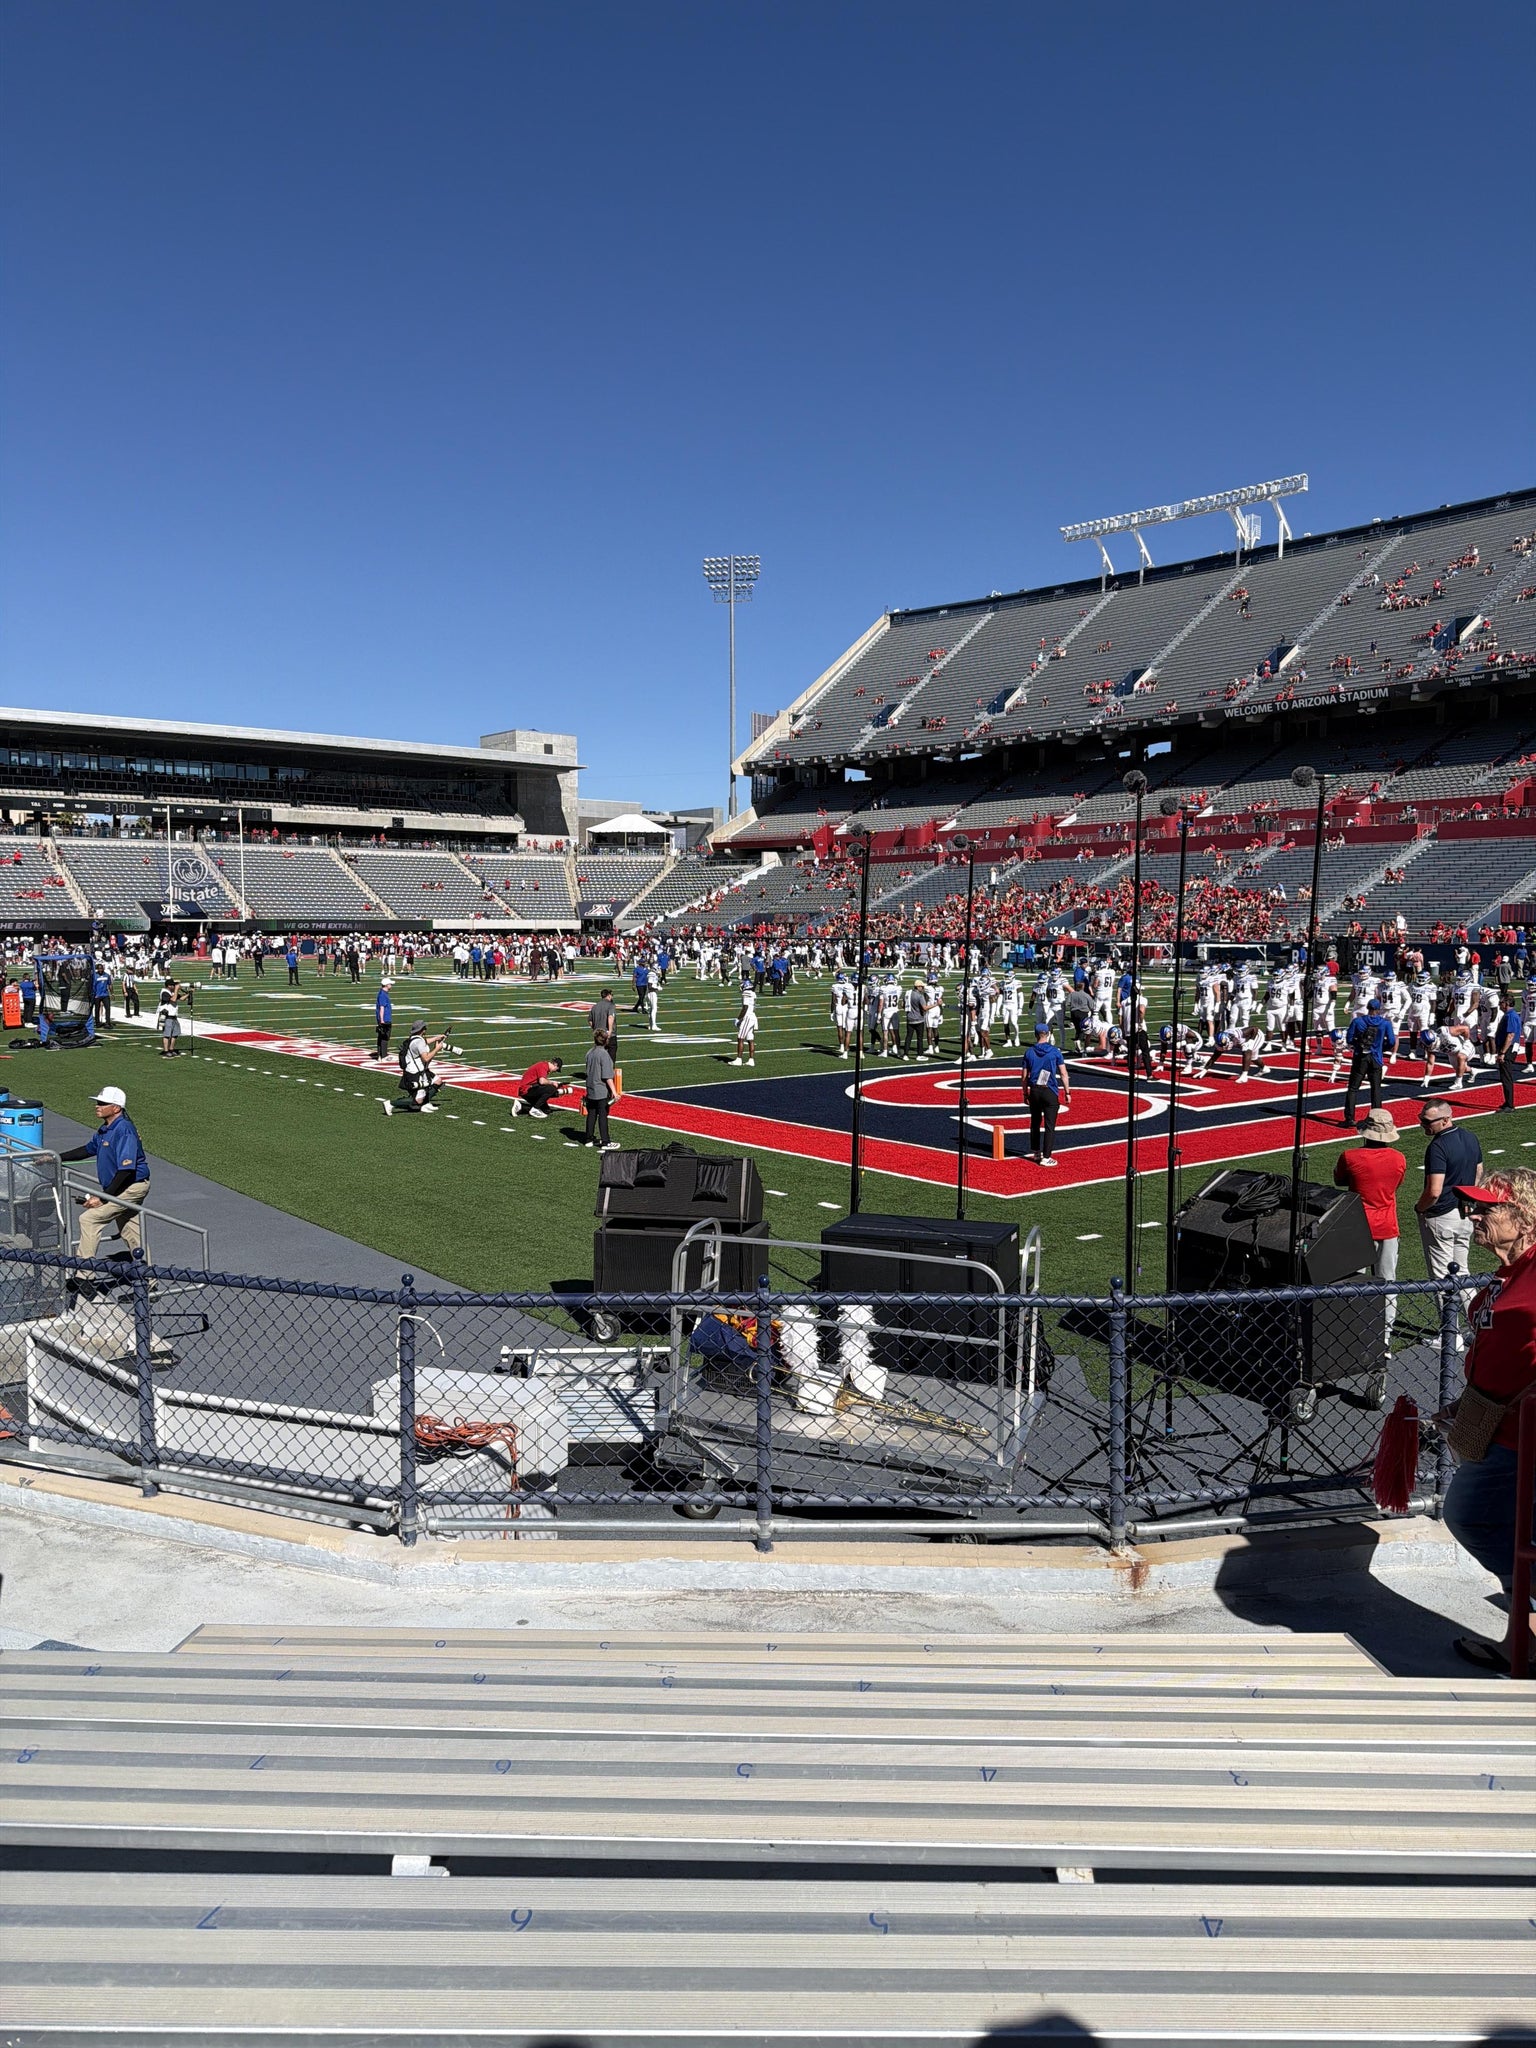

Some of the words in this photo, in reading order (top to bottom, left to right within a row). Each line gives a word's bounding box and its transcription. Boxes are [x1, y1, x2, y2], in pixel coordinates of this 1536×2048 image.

[1454, 676, 1471, 684] Vegas
[1224, 703, 1273, 718] WELCOME
[1275, 702, 1289, 711] TO
[1291, 695, 1337, 709] ARIZONA
[1339, 687, 1389, 703] STADIUM
[165, 886, 219, 902] Allstate
[0, 922, 14, 930] HE
[15, 922, 48, 930] EXTRA
[1103, 976, 1112, 988] 61
[887, 994, 898, 1008] 13
[1382, 991, 1393, 1004] 94
[17, 1745, 40, 1764] 8
[495, 1759, 512, 1775] 6
[979, 1766, 997, 1782] 4
[195, 1899, 227, 1930] 7
[510, 1908, 533, 1932] 6
[868, 1908, 889, 1935] 5
[1199, 1914, 1223, 1938] 4
